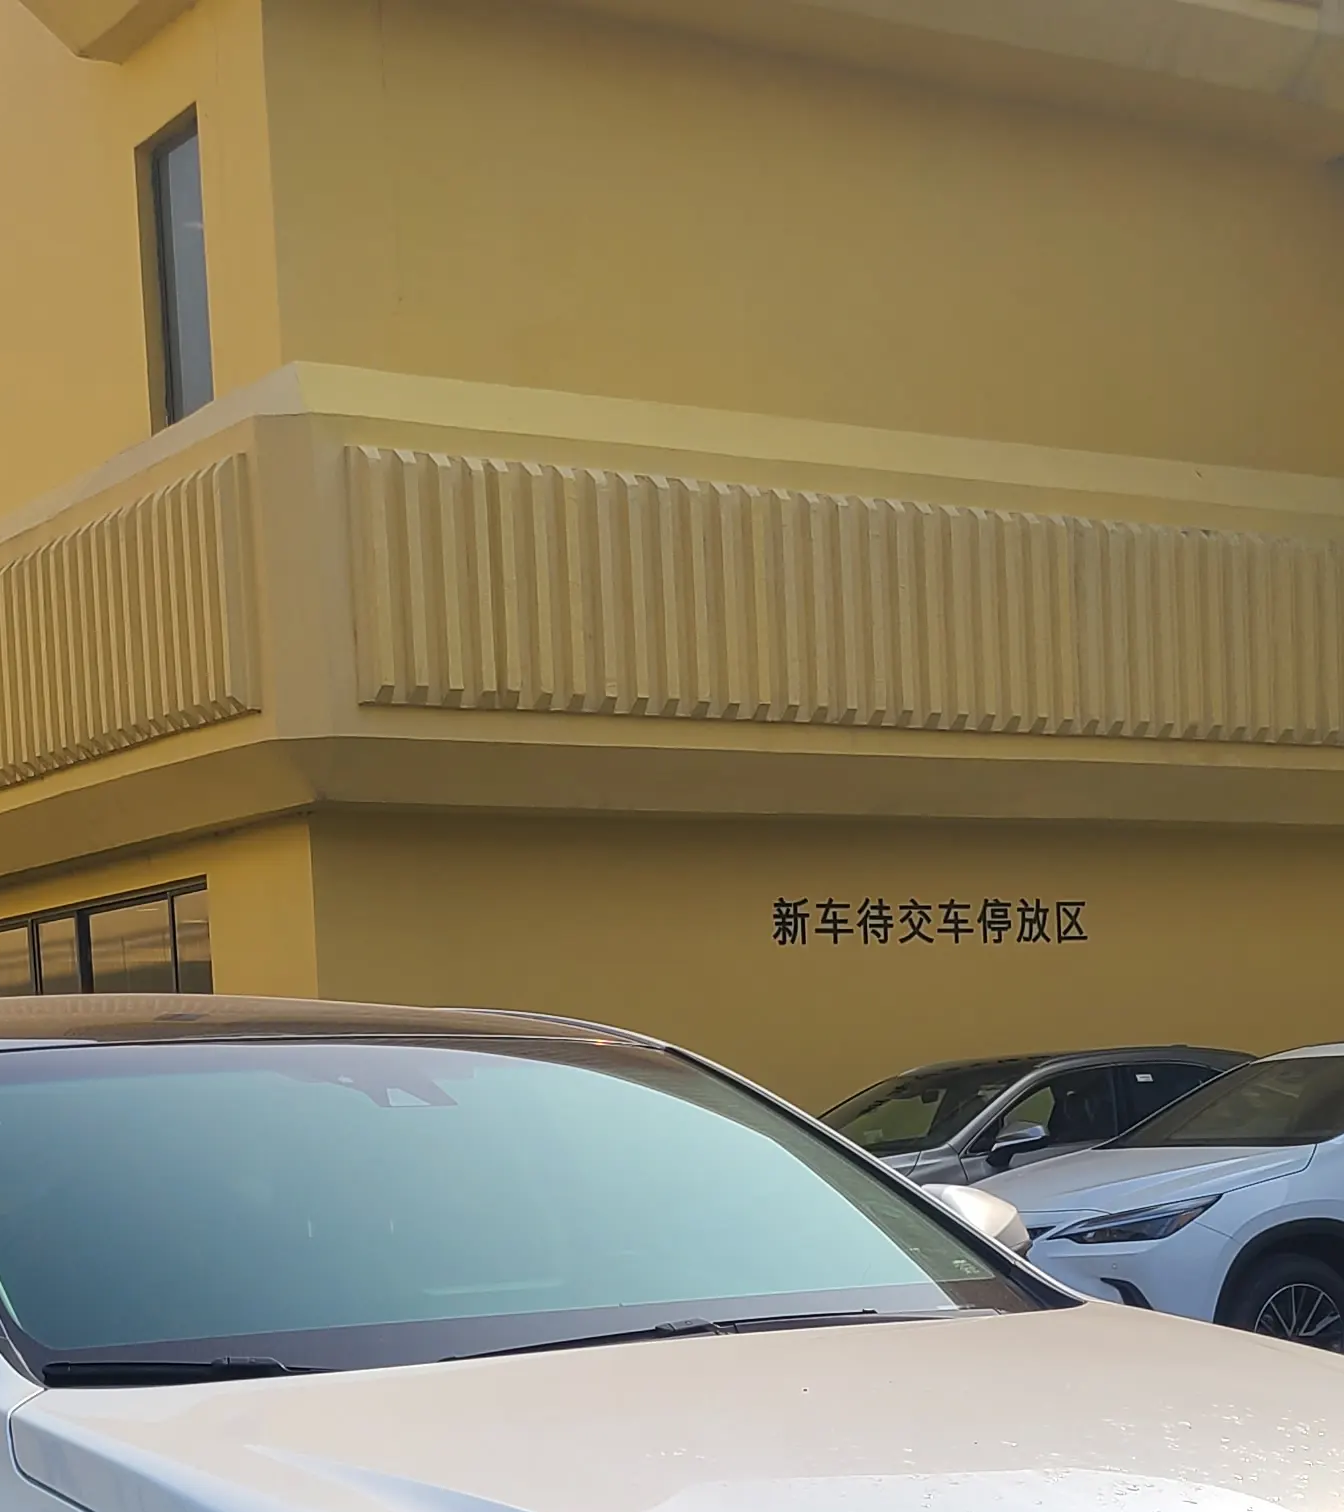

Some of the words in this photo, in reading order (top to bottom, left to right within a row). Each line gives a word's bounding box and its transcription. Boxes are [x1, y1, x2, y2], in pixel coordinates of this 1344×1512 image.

[772, 897, 1088, 945] 新车待交车停放区
